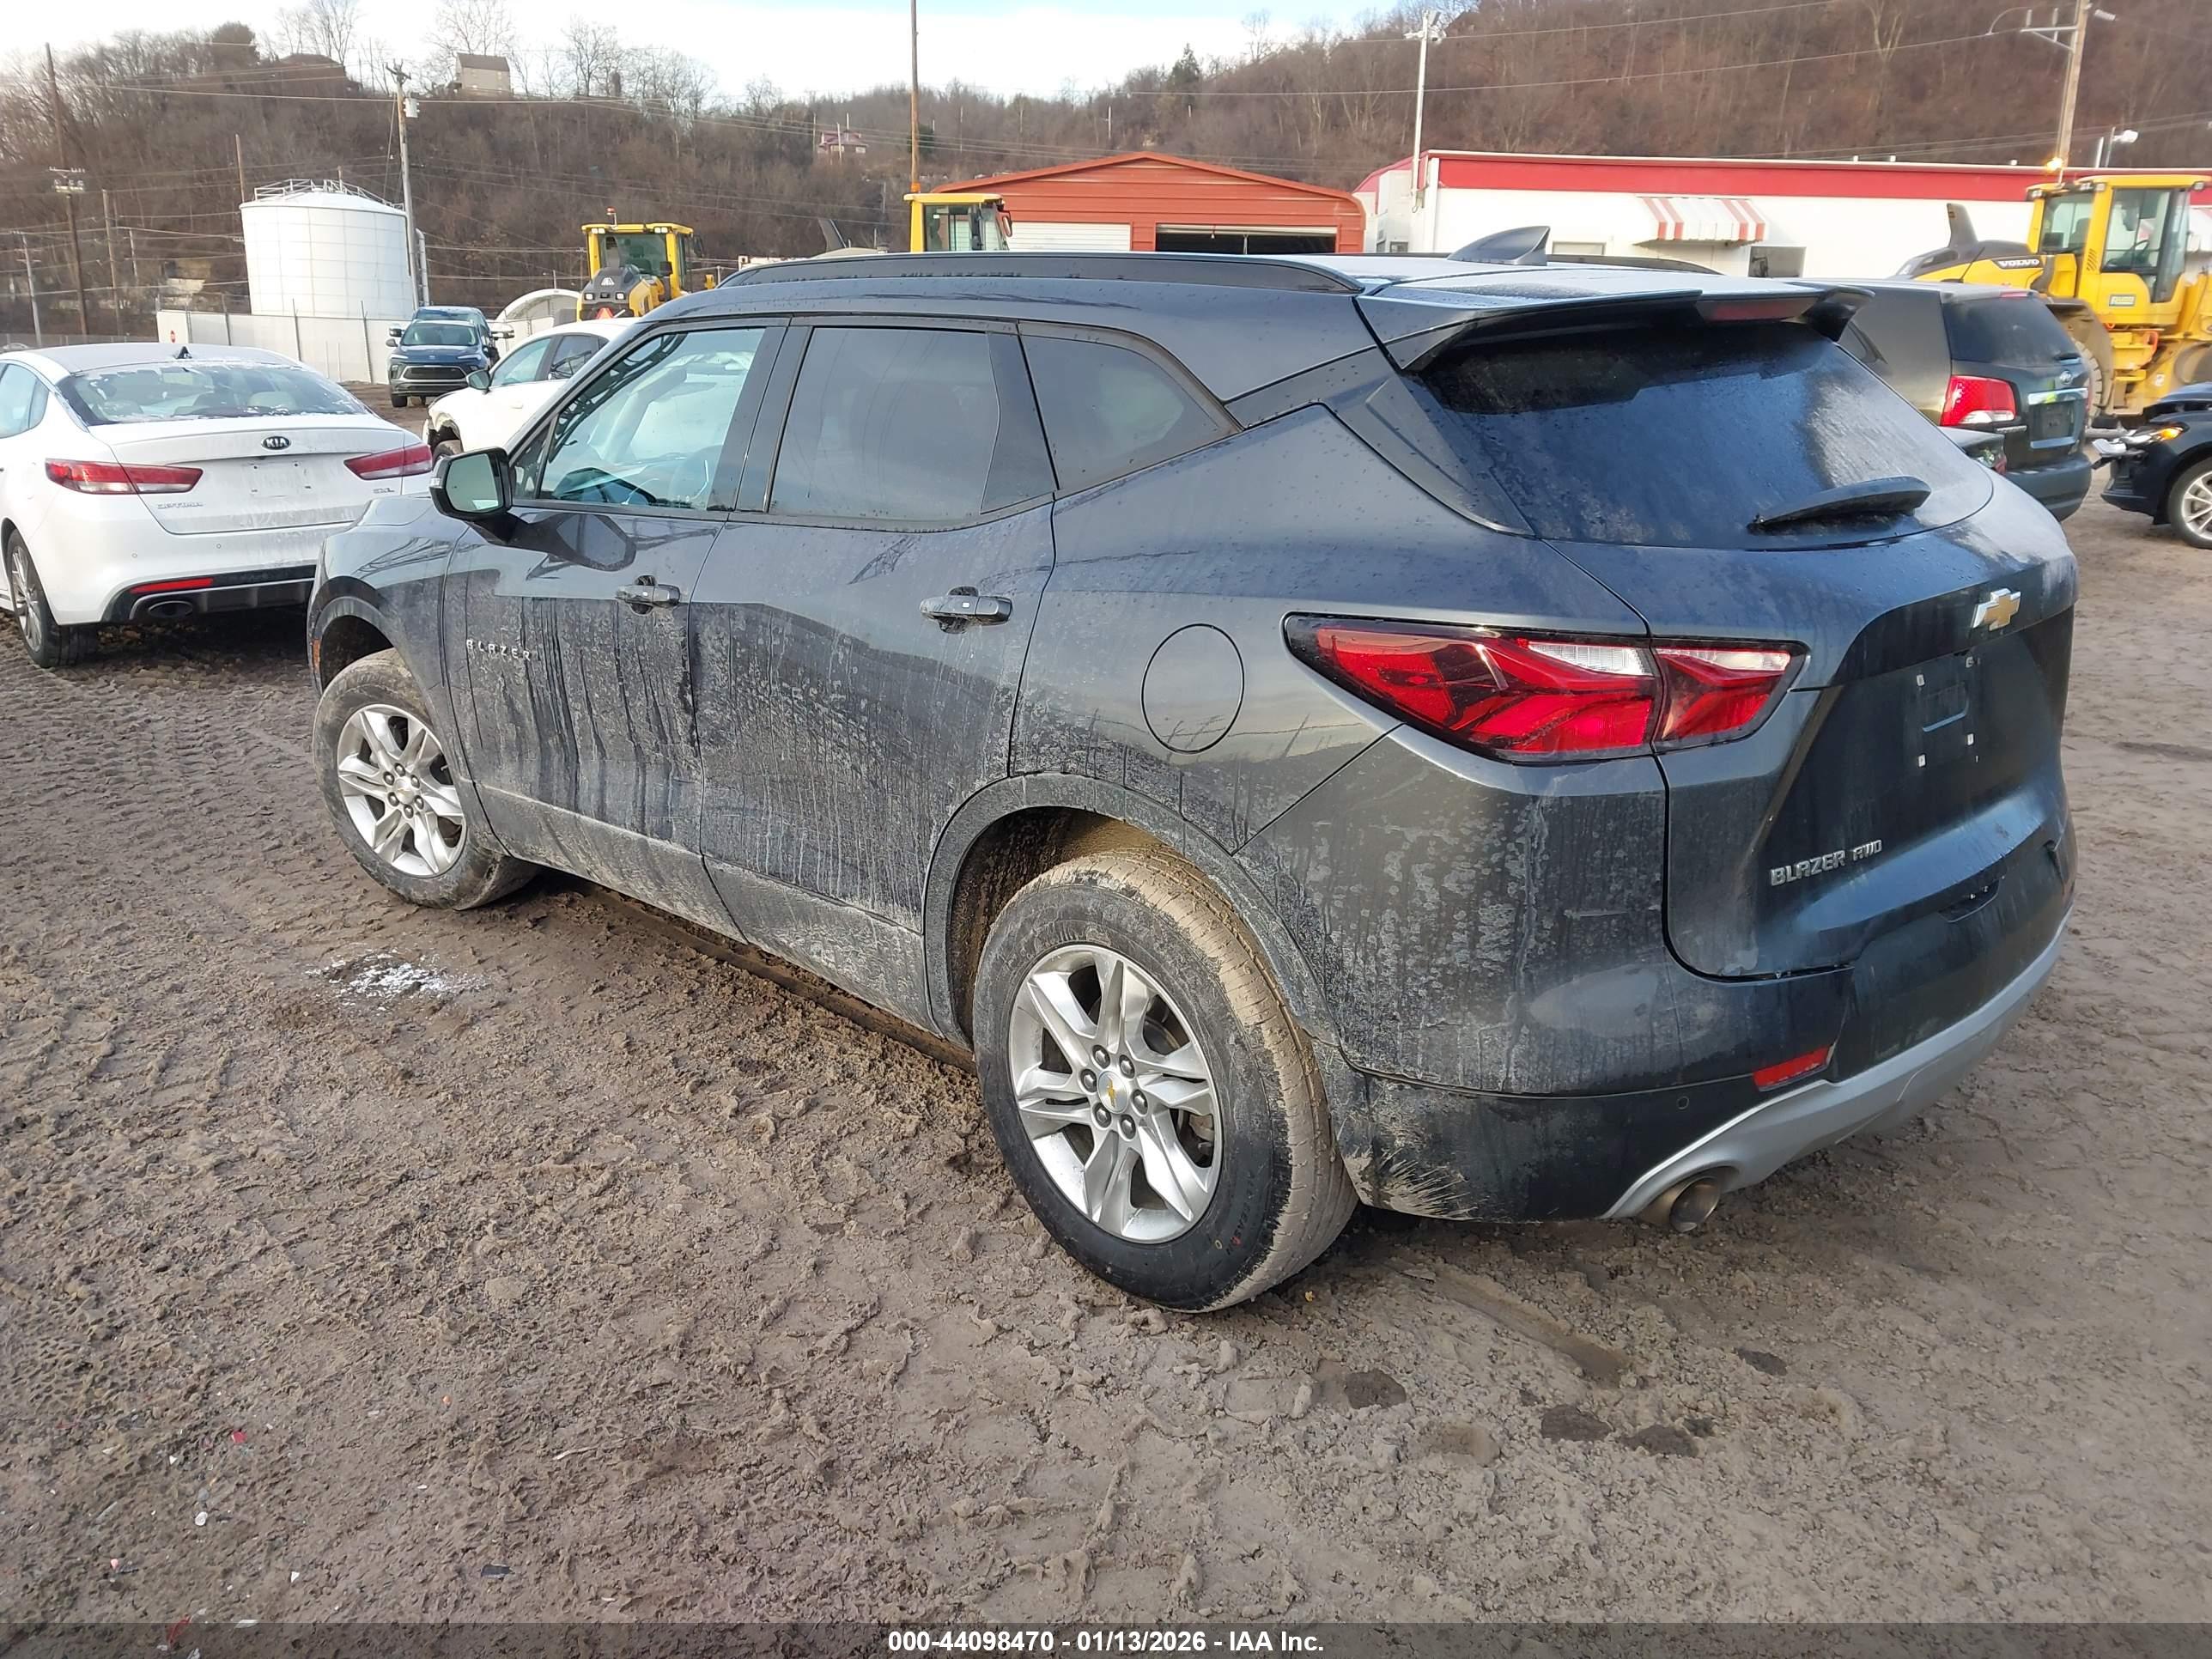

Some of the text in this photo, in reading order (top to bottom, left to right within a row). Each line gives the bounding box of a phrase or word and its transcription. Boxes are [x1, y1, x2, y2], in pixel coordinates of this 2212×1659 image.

[1997, 258, 2040, 268] VOLVO
[265, 438, 288, 447] KIA
[465, 639, 531, 661] BLAZER
[1771, 839, 1882, 886] BLAZER AWD
